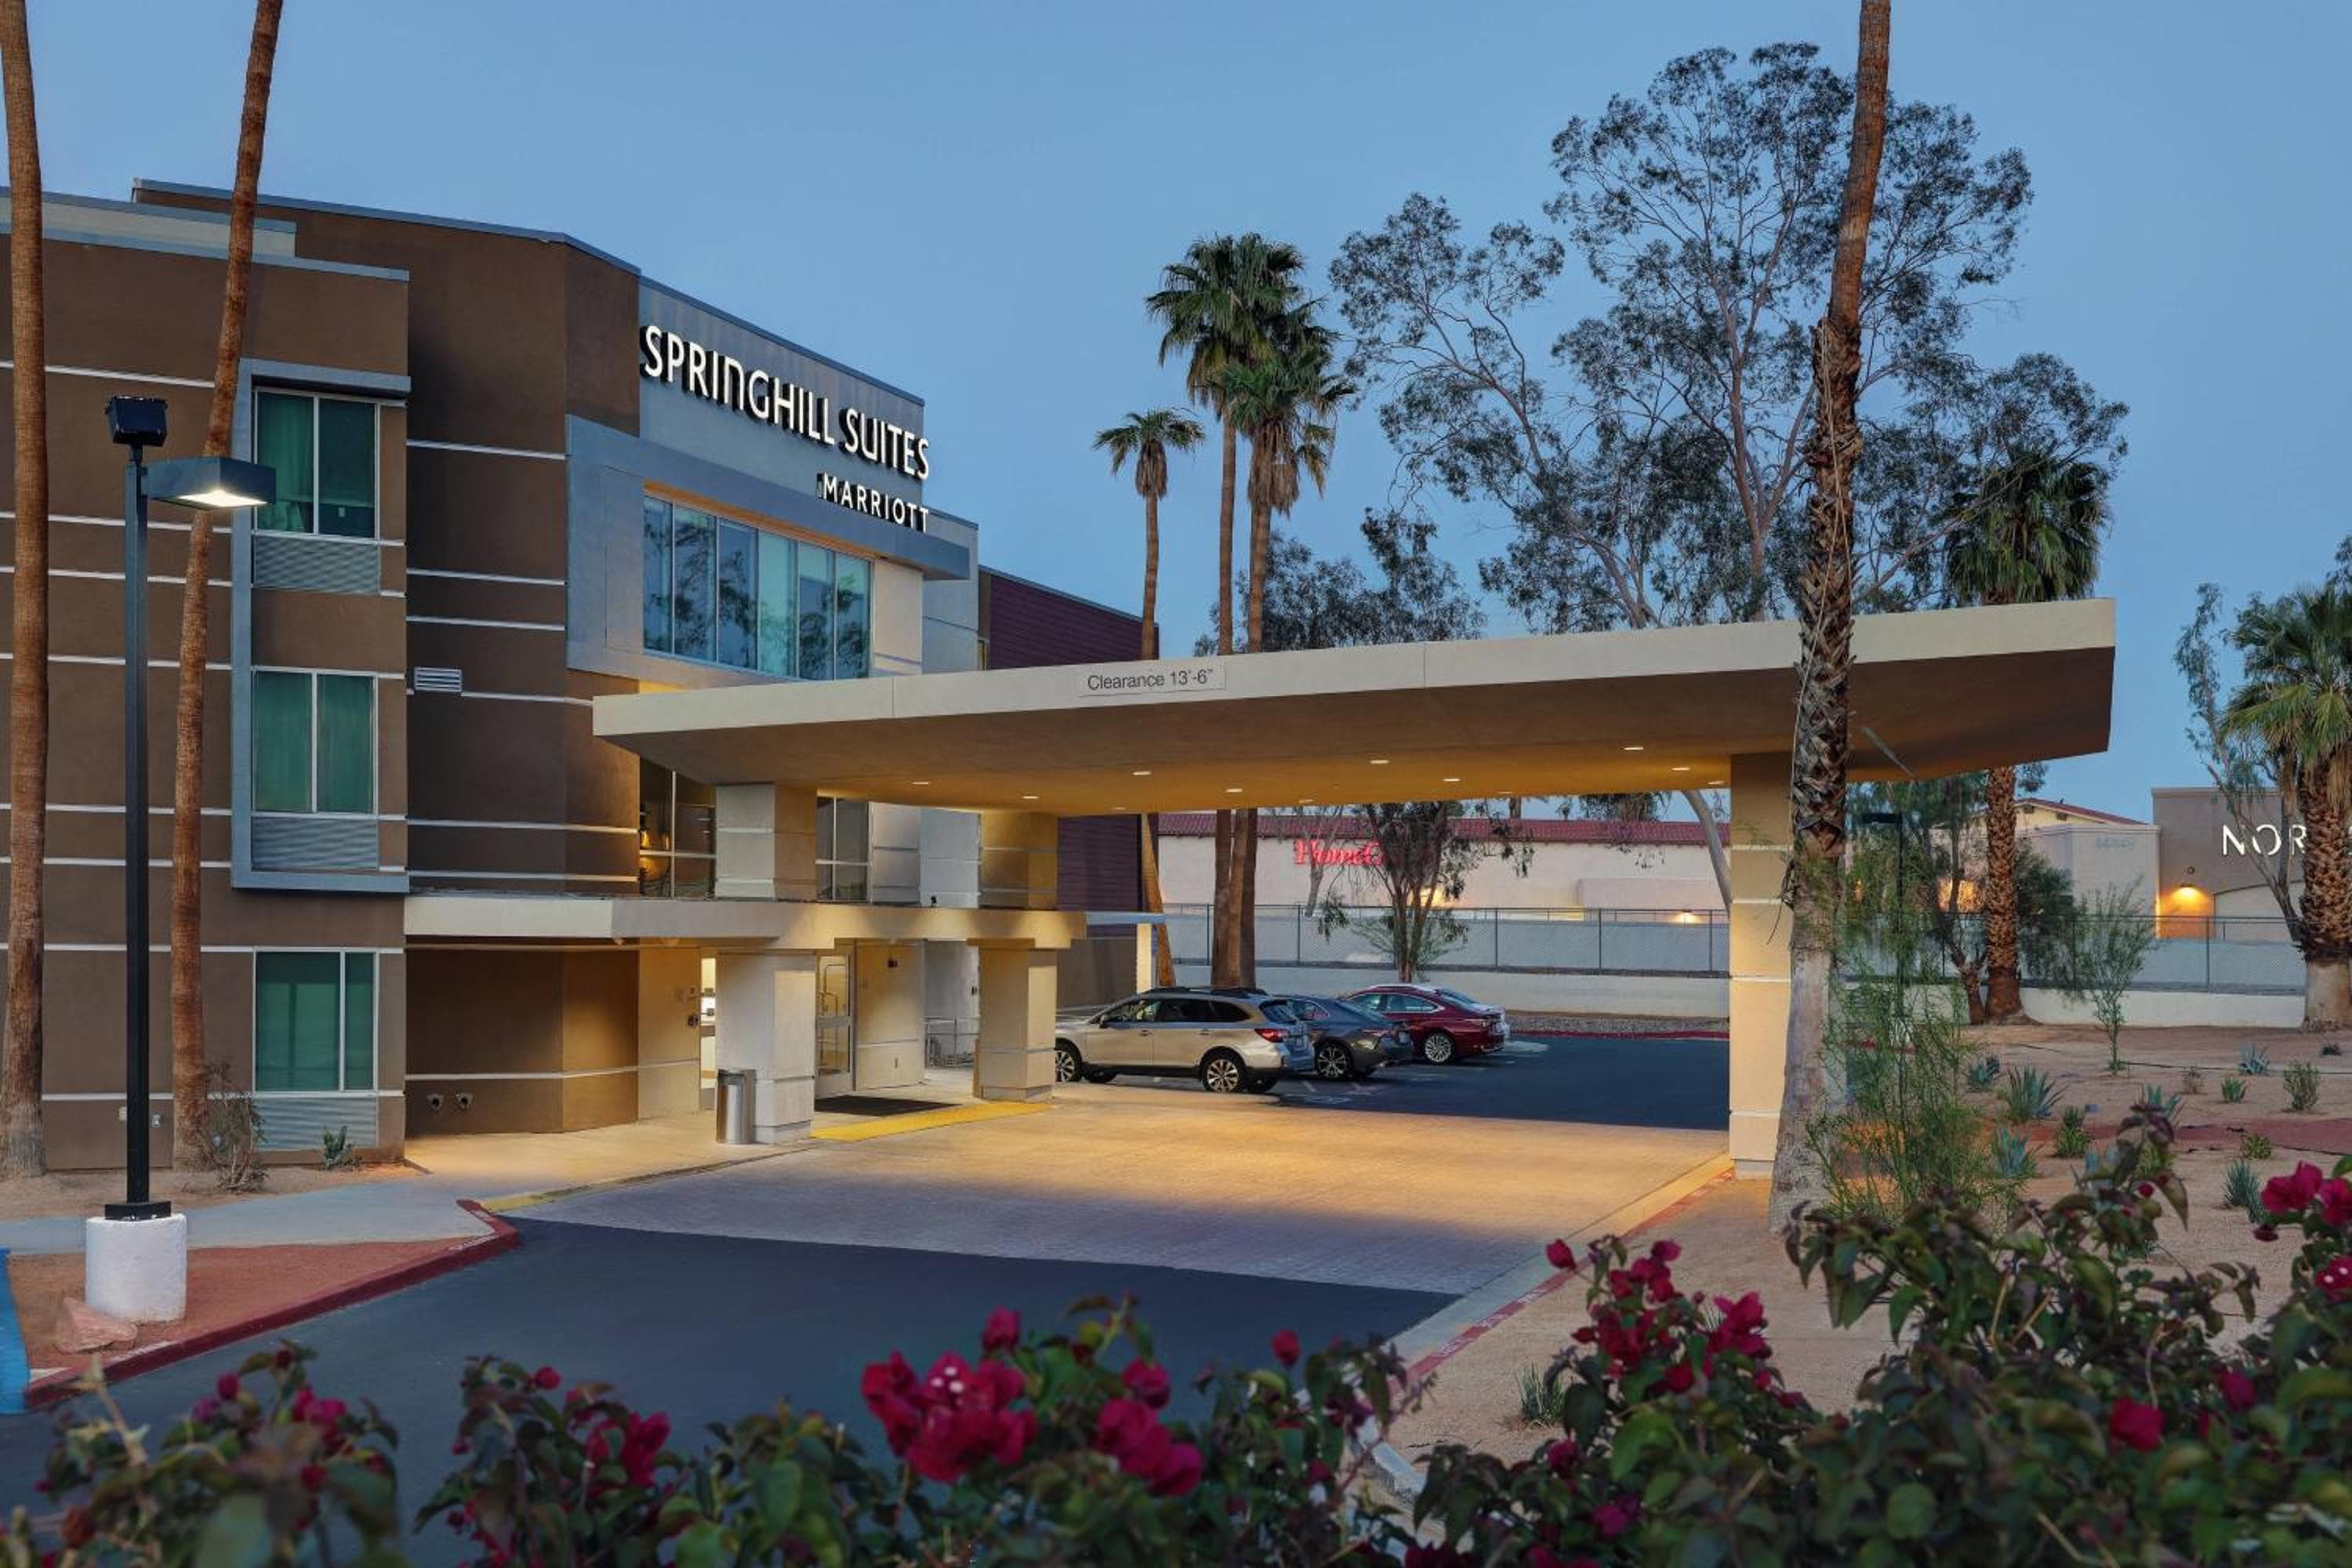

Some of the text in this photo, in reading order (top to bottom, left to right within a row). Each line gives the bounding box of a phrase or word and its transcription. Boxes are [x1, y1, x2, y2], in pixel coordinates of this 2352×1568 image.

[643, 325, 929, 480] SPRINGHILL SUITES
[822, 472, 929, 533] MARRIOTT
[1087, 674, 1165, 691] Clearance
